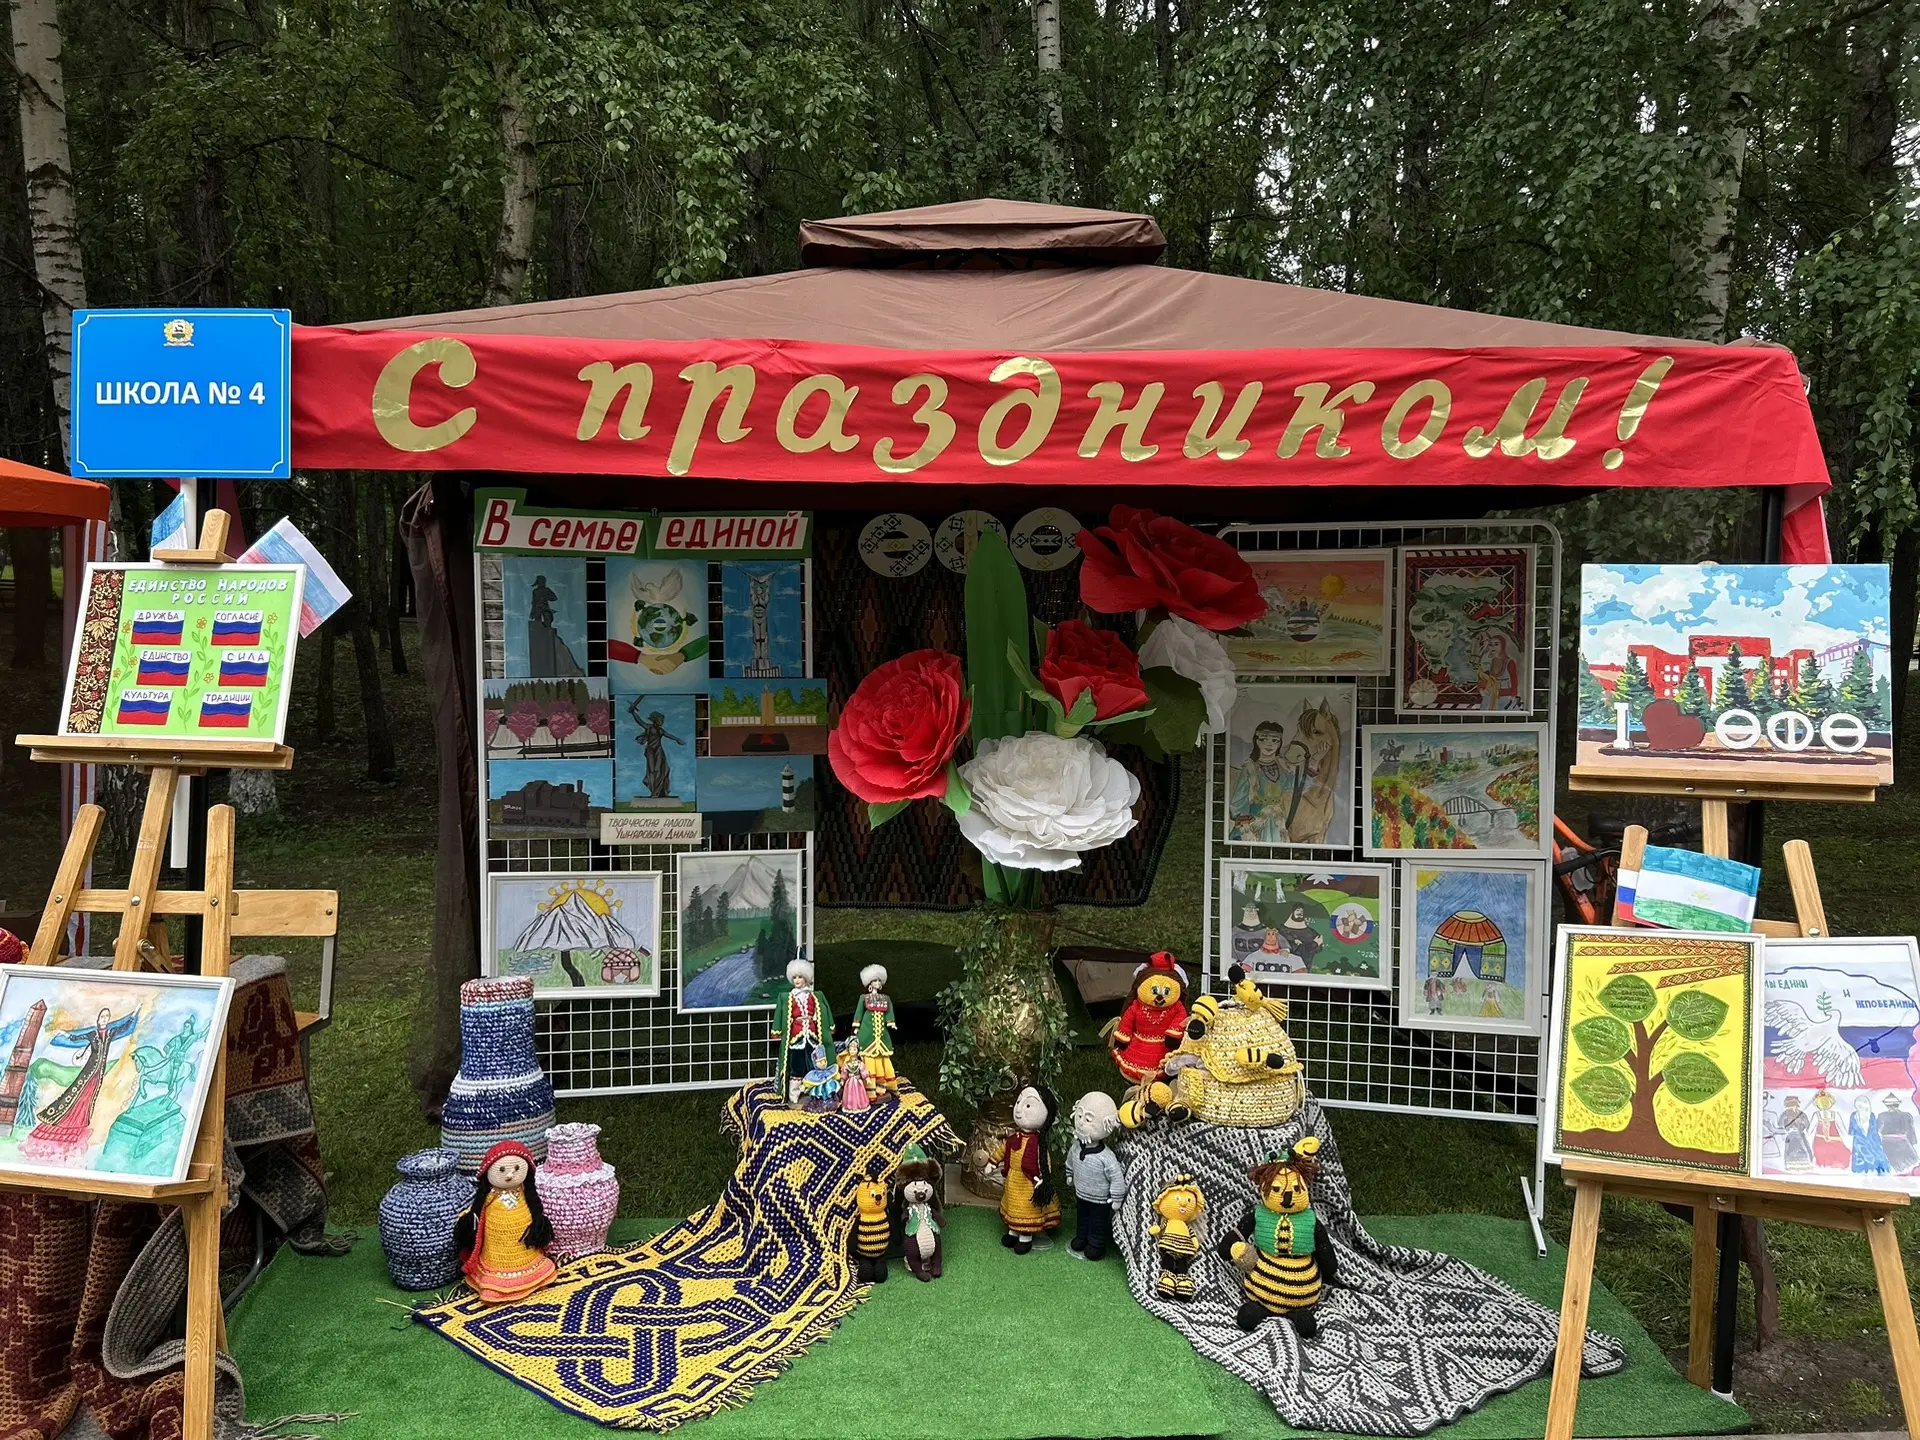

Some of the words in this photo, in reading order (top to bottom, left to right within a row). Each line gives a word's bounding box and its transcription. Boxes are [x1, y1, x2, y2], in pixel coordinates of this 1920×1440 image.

[96, 381, 201, 405] ШКОЛА
[208, 381, 241, 405] №
[248, 381, 266, 405] 4
[371, 337, 478, 453] С
[575, 354, 1675, 477] праздником!
[481, 498, 512, 546] В
[527, 517, 640, 552] семье
[664, 510, 800, 549] единой
[127, 578, 208, 594] ЕДИНСТВО
[216, 578, 289, 593] НАРОДОВ
[171, 592, 250, 606] РОССИИ
[136, 611, 180, 622] ДРУЖБА
[215, 611, 260, 622] СОГЛАСИЕ
[141, 650, 189, 662] ЕДИНСТВО
[226, 652, 266, 662] СИЛА
[122, 690, 171, 701] КУЛЬТУРА
[205, 692, 251, 703] ТРАДИЦИИ
[1778, 979, 1808, 990] ЕДИНЫ
